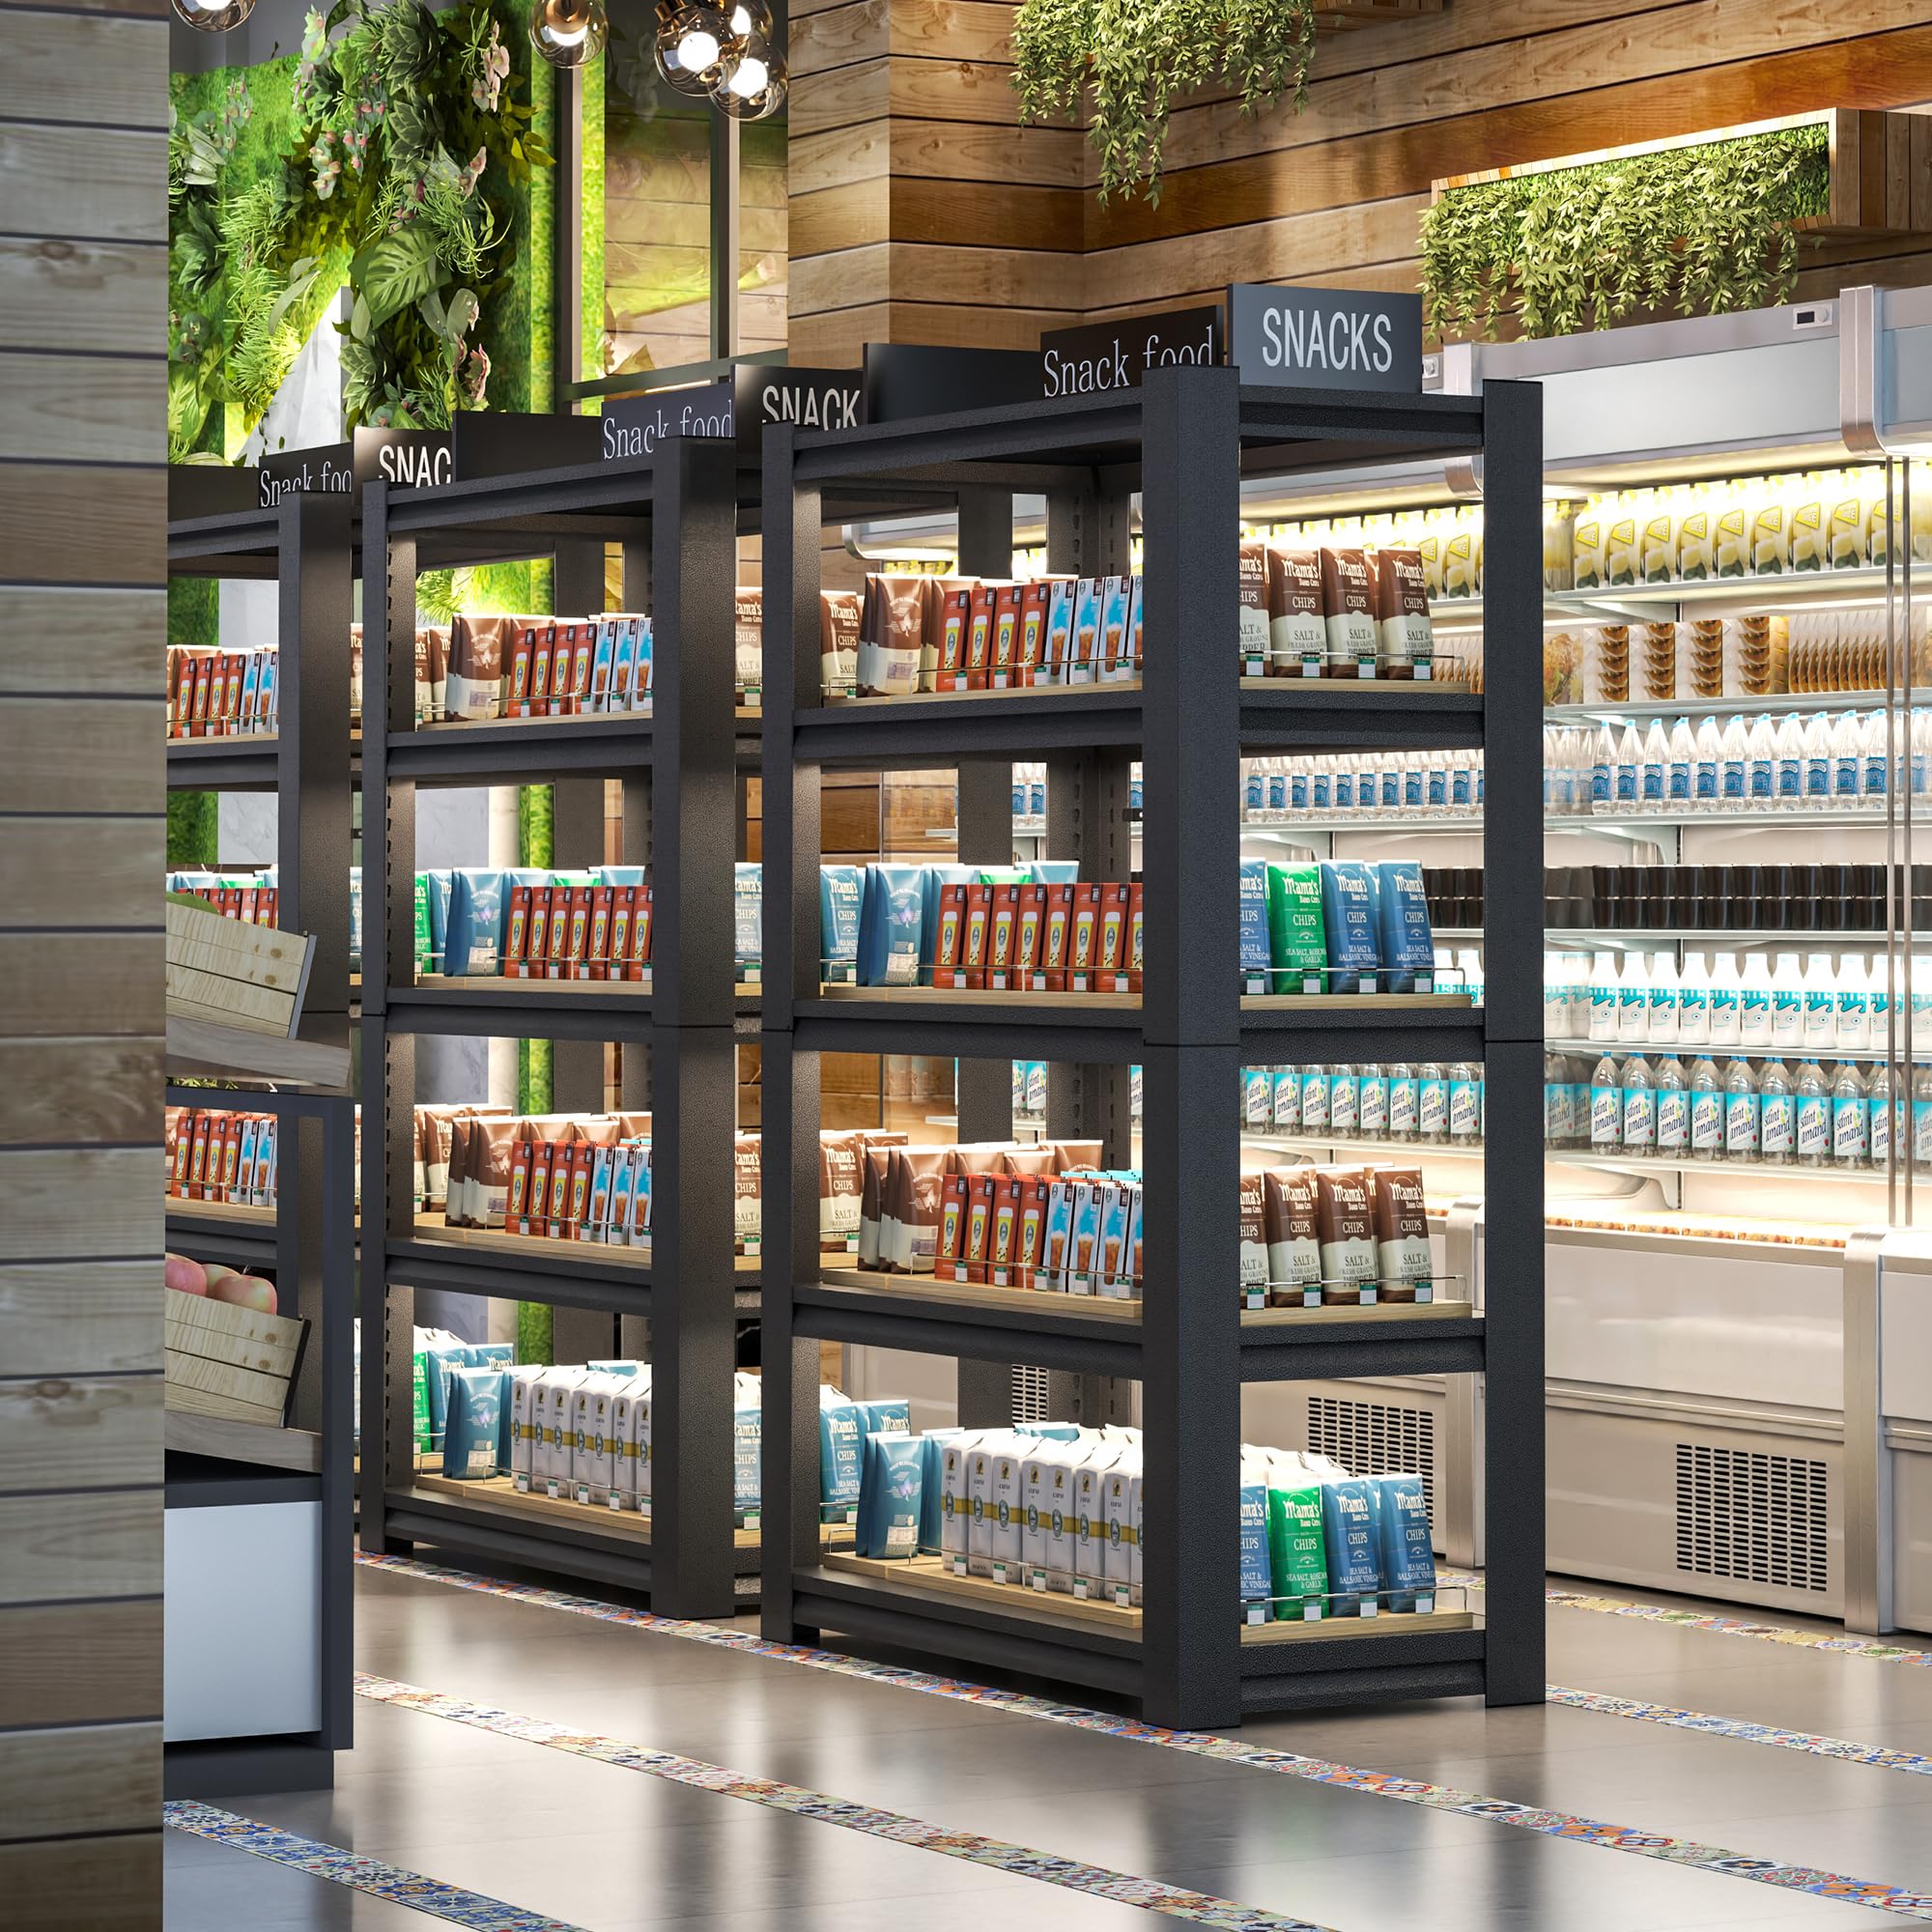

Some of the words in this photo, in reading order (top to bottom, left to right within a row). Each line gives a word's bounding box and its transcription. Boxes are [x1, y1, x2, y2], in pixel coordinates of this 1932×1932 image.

[1262, 307, 1392, 373] SNACKS
[1043, 338, 1130, 397] Snack
[762, 385, 862, 431] SNACK
[604, 410, 669, 460] Snack
[1281, 559, 1319, 579] Mama's
[1335, 558, 1367, 579] Mama's
[1239, 590, 1258, 602] HIPS
[1346, 595, 1366, 607] CHIPS
[1293, 596, 1317, 609] CHIPS
[1404, 597, 1424, 609] CHIPS
[1239, 624, 1255, 635] ALT
[1294, 630, 1315, 640] SALT
[1349, 629, 1366, 639] SALT
[1406, 630, 1424, 640] SALT
[838, 635, 857, 645] CHIPS
[1282, 876, 1319, 895] Mama's
[1335, 874, 1367, 893] Mama's
[838, 910, 857, 921] CHIPS
[1240, 910, 1259, 922] HIPS
[1293, 914, 1317, 926] CHIPS
[1347, 912, 1367, 923] CHIPS
[1405, 912, 1424, 923] CHIPS
[833, 1179, 854, 1190] CHIPS
[1279, 1183, 1311, 1202] Mama's
[1331, 1184, 1366, 1202] Mama's
[1389, 1182, 1423, 1200] Mama's
[1240, 1224, 1258, 1236] HIPS
[1291, 1221, 1311, 1233] CHIPS
[1343, 1221, 1365, 1233] CHIPS
[1401, 1219, 1422, 1232] CHIPS
[1240, 1260, 1257, 1270] ALT
[1293, 1255, 1310, 1265] SALT
[1345, 1256, 1363, 1266] SALT
[1403, 1254, 1421, 1264] SALT
[838, 1451, 857, 1461] CHIPS
[1283, 1500, 1320, 1519] Mama's
[1336, 1495, 1368, 1513] Mama's
[1348, 1532, 1368, 1545] CHIPS
[1406, 1528, 1426, 1541] CHIPS
[1240, 1538, 1259, 1549] HIPS
[1293, 1538, 1318, 1550] CHIPS
